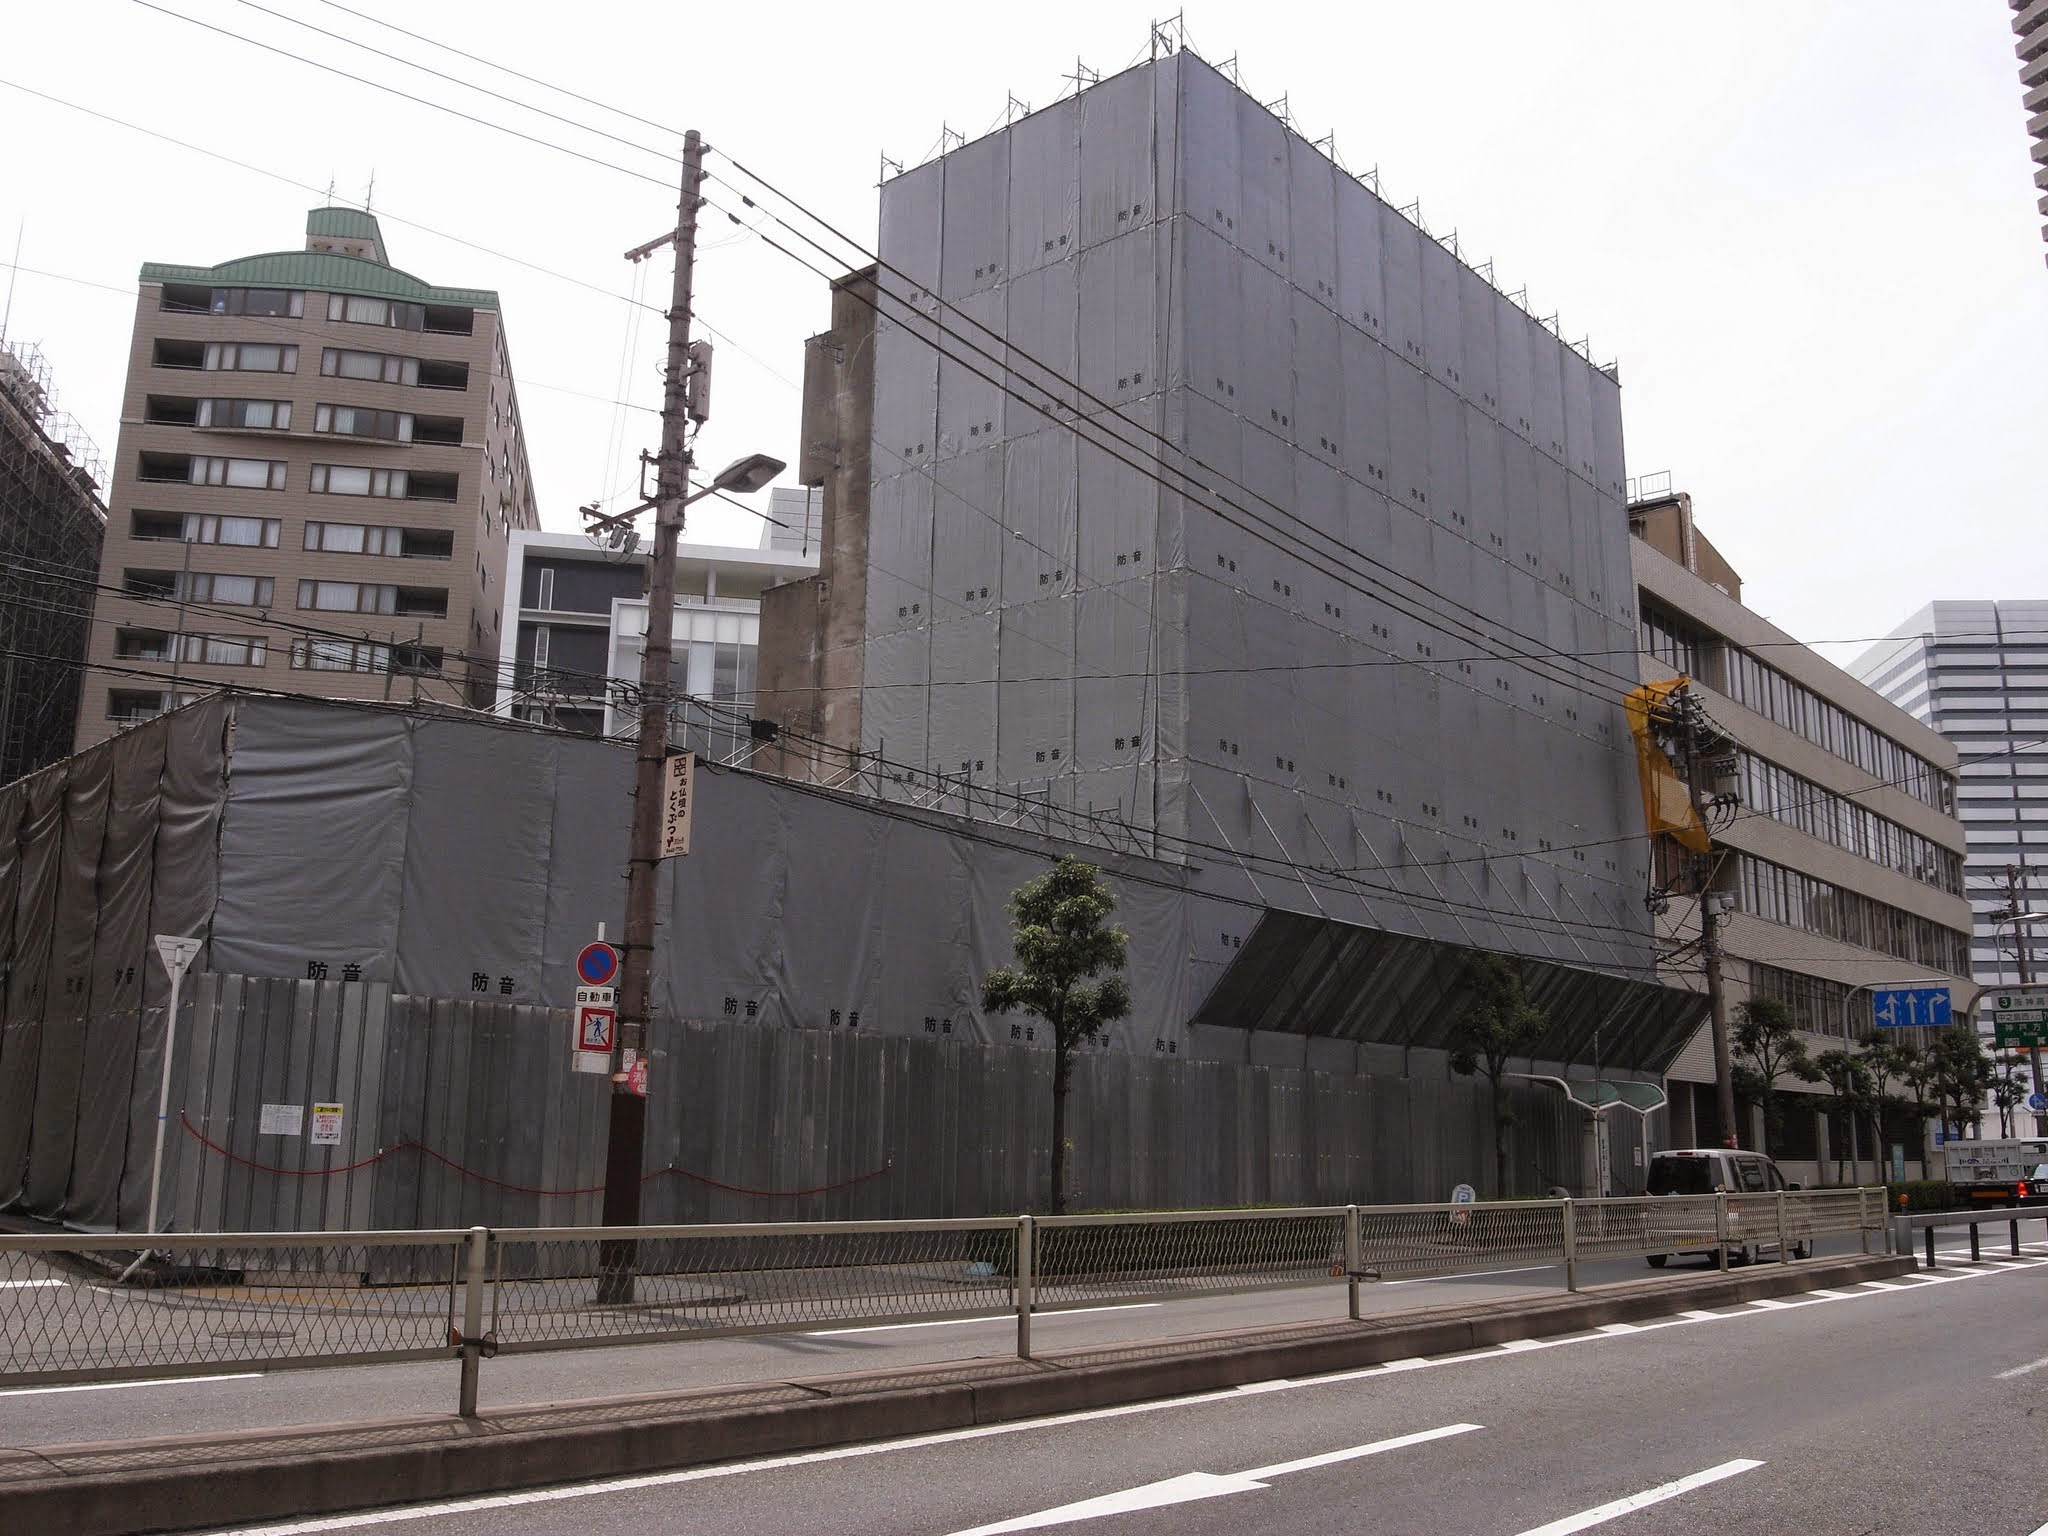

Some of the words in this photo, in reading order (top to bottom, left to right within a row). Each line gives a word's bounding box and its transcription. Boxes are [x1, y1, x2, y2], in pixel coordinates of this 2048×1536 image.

[1118, 204, 1142, 222] 防音
[1045, 235, 1068, 253] 防音
[1118, 372, 1142, 390] 防音
[970, 421, 993, 438] 防音
[1116, 550, 1142, 567] 防音
[1039, 569, 1064, 586] 防音
[965, 586, 989, 602] 防音
[899, 603, 920, 618] 防音
[1114, 735, 1142, 751] 防音
[1035, 748, 1060, 763] 防音
[678, 778, 687, 818] お仏壇の
[667, 790, 677, 835] とくぶつ
[308, 961, 362, 982] 防音
[472, 972, 515, 995] 防音
[578, 991, 612, 1003] 自動車
[724, 997, 758, 1017] 防音
[830, 1009, 859, 1028] 防音
[925, 1017, 953, 1034] 防音
[1010, 1024, 1035, 1042] 防音
[1156, 1037, 1177, 1054] 防音
